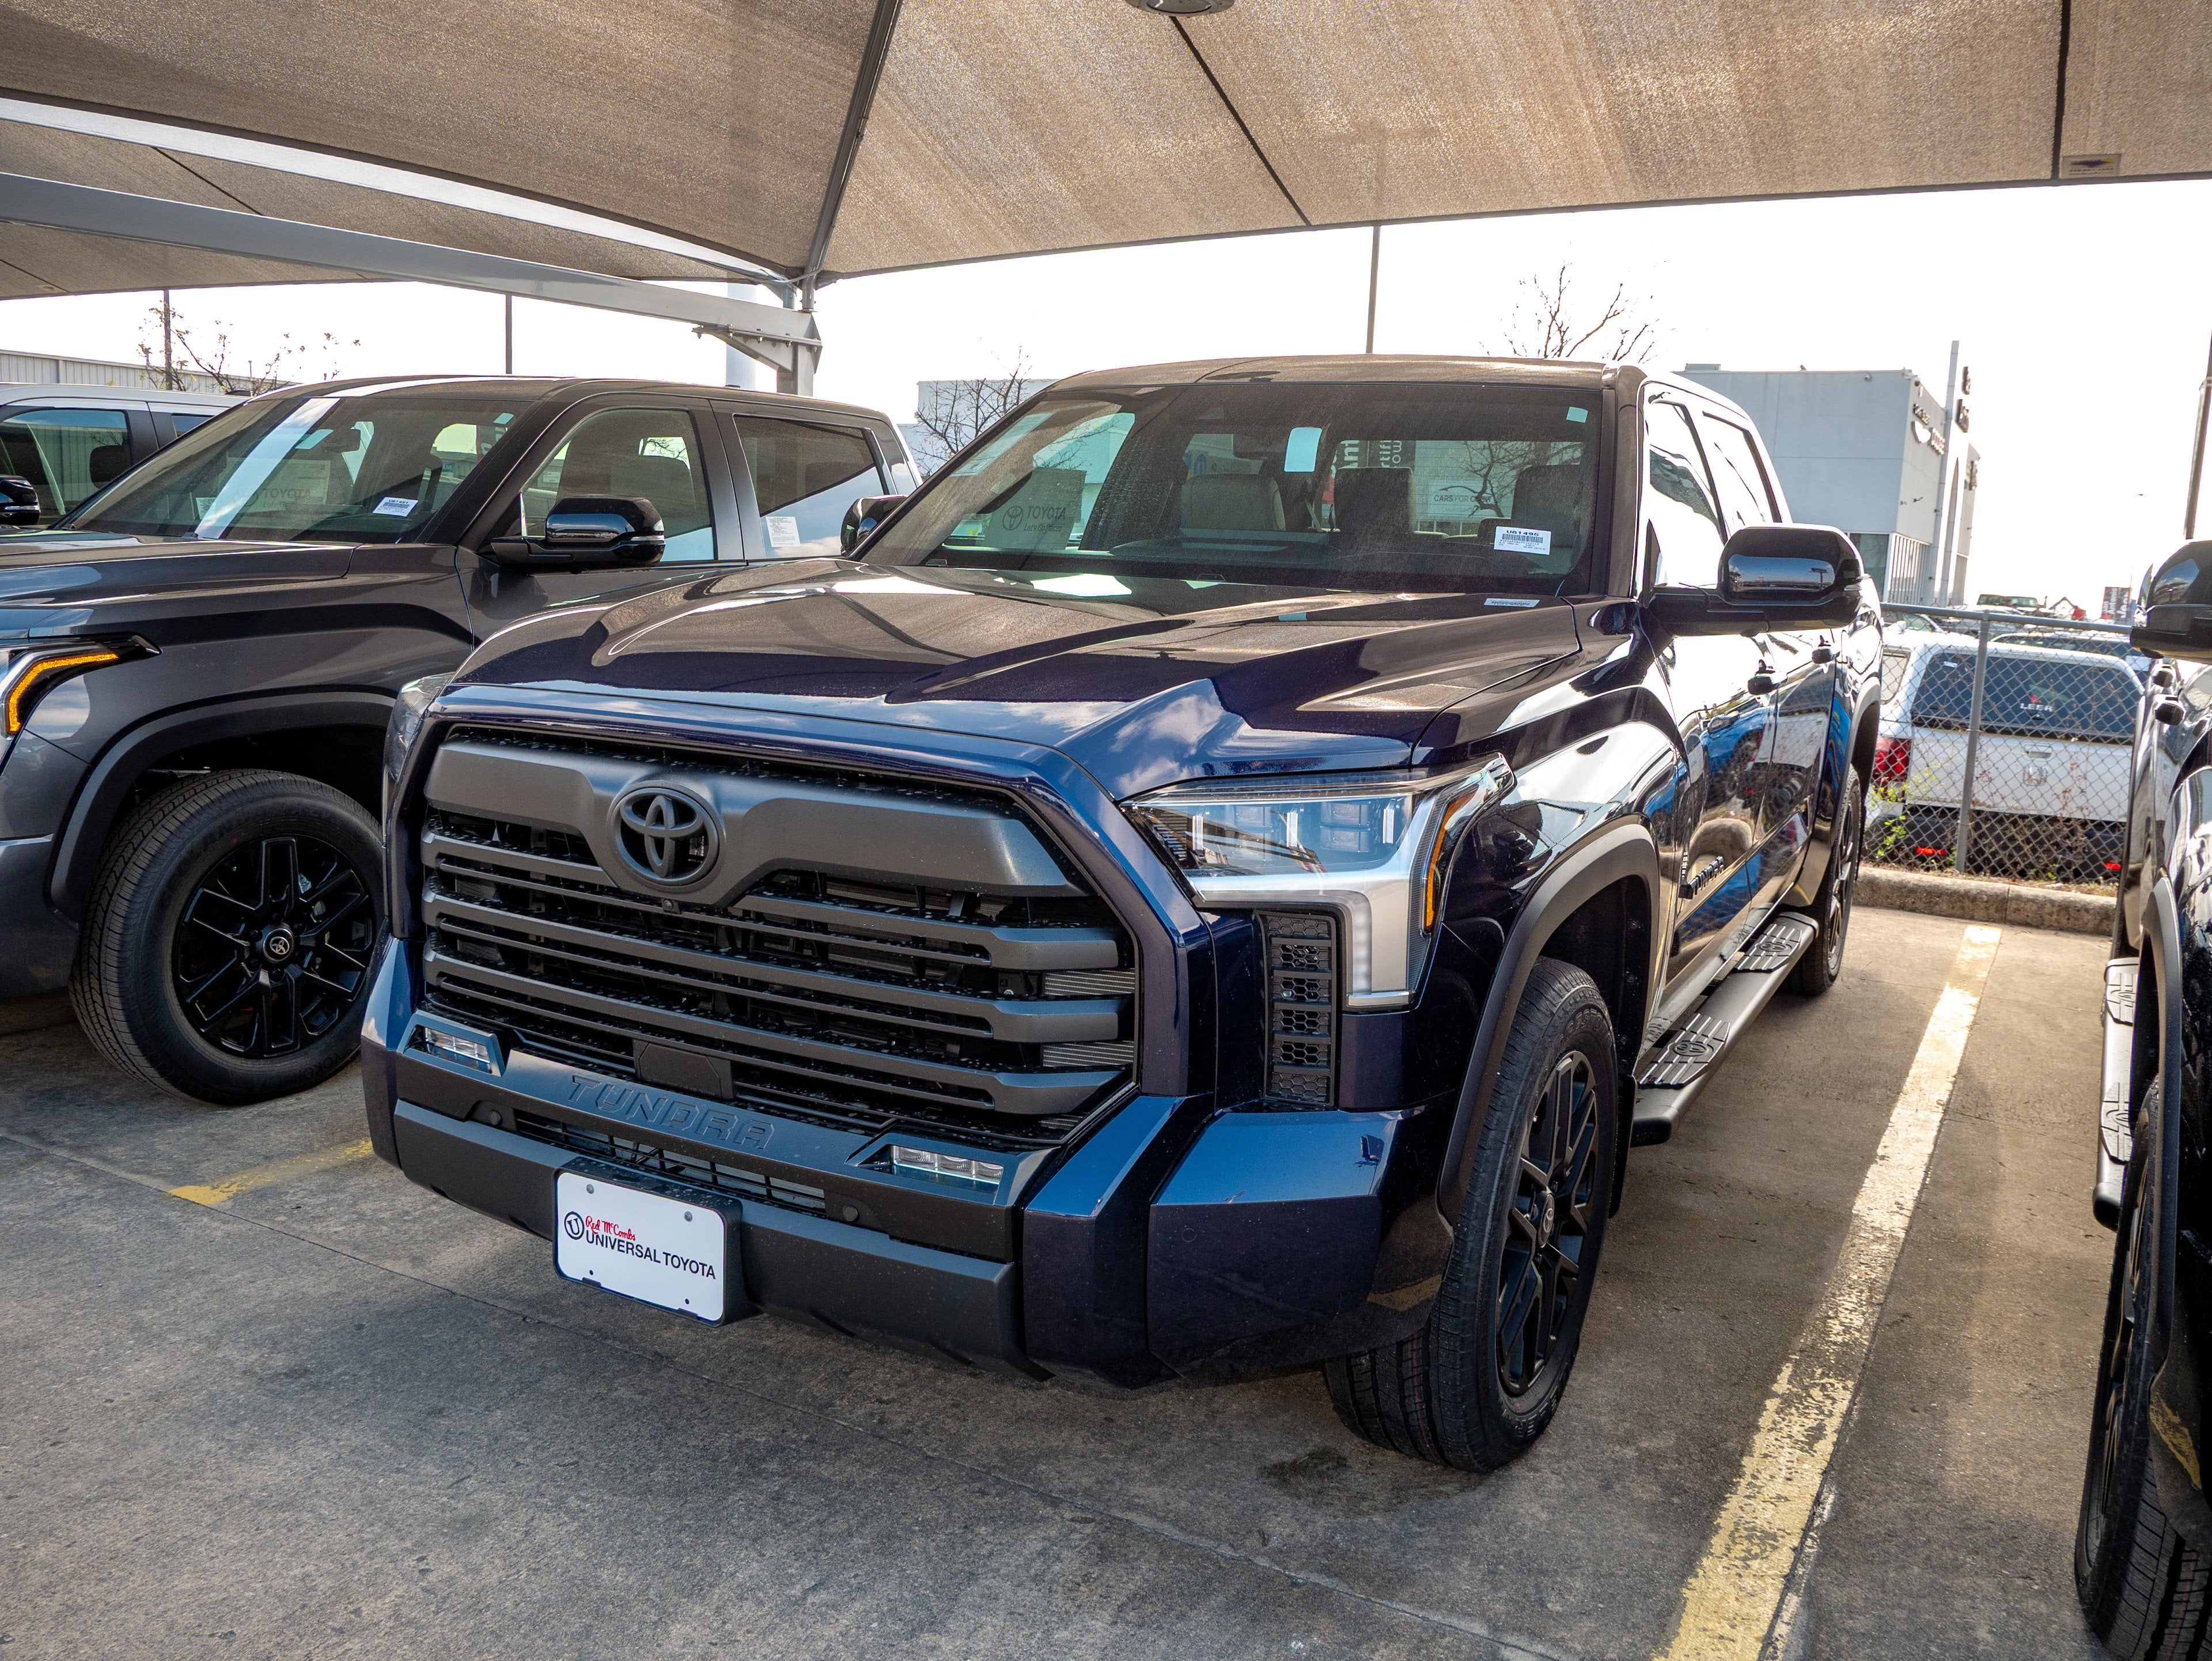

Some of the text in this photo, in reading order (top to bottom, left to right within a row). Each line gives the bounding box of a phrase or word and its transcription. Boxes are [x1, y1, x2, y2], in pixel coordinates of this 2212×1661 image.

[1027, 505, 1066, 520] TOYOTA
[2020, 703, 2054, 713] LEER
[568, 1074, 775, 1151] TUNDRA
[585, 1216, 635, 1241] Red McCombs
[586, 1229, 716, 1280] UNIVERSAL TOYOTA
